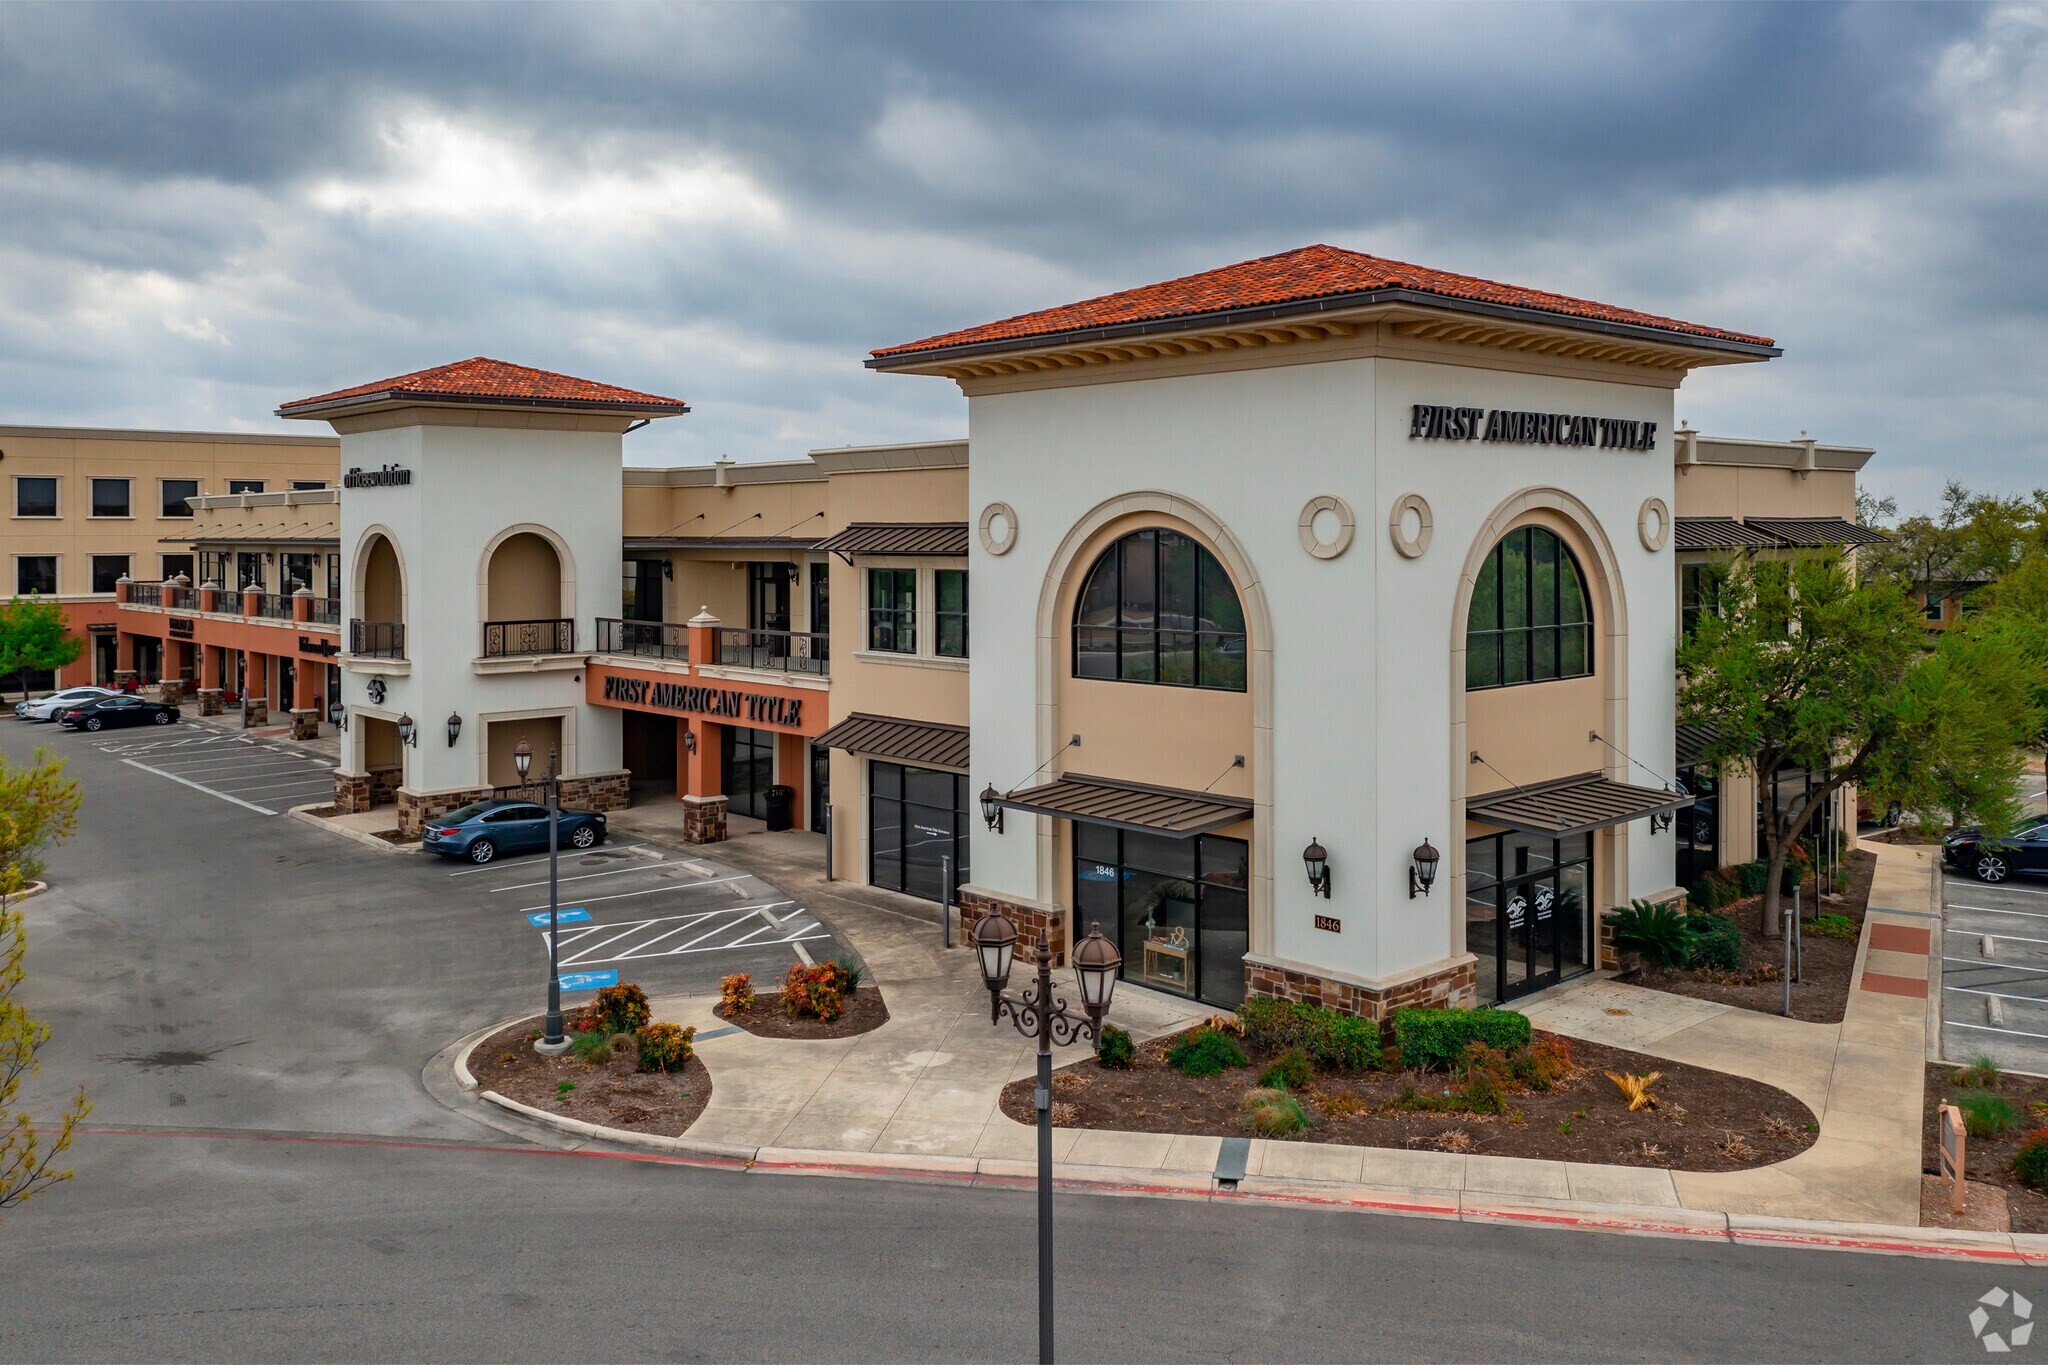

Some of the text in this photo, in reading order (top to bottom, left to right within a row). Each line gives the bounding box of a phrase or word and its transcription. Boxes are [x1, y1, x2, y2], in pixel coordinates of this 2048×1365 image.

[1409, 404, 1657, 450] FIRST AMERICAN TITLE
[603, 676, 803, 728] FIRST AMERICAN TITLE
[1095, 865, 1115, 877] 1846
[1316, 916, 1340, 932] 1846
